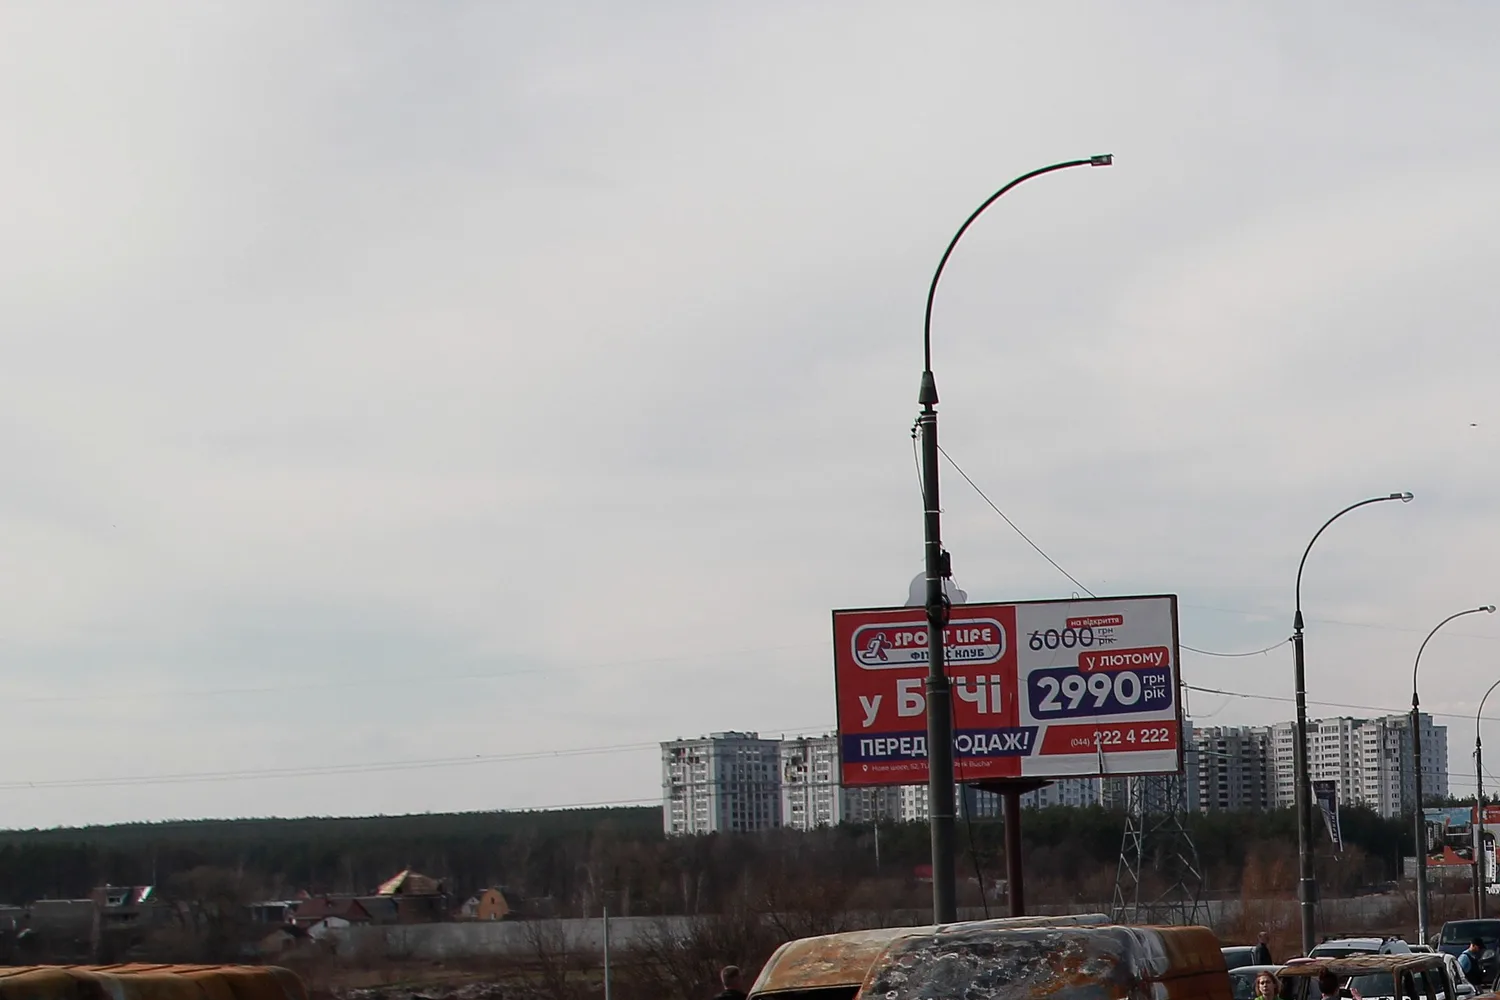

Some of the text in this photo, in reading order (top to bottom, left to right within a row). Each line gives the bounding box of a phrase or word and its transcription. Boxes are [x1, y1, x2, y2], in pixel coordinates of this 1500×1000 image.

[1082, 616, 1120, 627] відкриття
[895, 628, 992, 647] SPOT LIFE
[1029, 626, 1094, 650] 6000
[955, 648, 985, 659] КЛУБ
[1086, 651, 1164, 670] у лютому
[1143, 674, 1165, 685] грн
[859, 674, 1001, 727] у БЧІ
[1037, 671, 1141, 712] 2990
[1144, 686, 1165, 701] рік
[860, 731, 1029, 757] ПЕРЕДОДАЖ!
[1071, 728, 1169, 747] (044) 222 4 222
